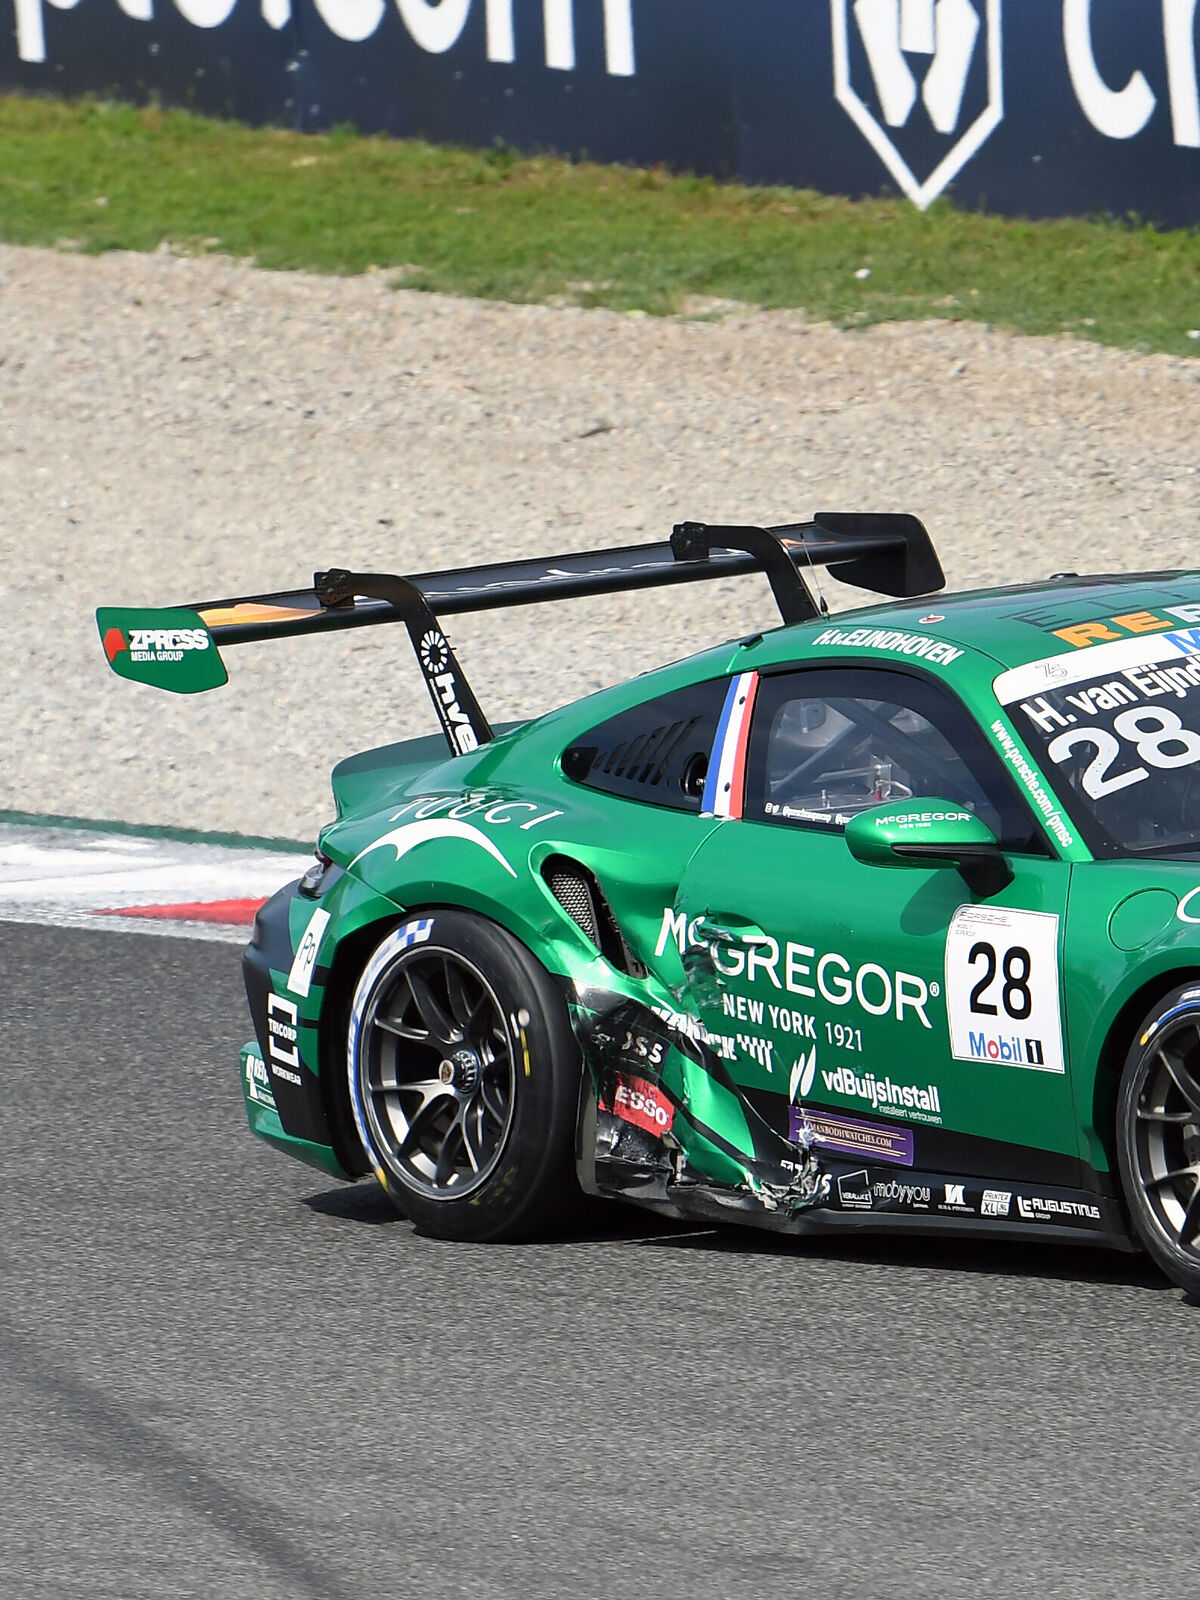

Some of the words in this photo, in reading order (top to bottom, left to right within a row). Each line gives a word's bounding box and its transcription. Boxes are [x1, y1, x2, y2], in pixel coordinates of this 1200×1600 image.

[129, 629, 209, 650] ZPRESS
[131, 651, 156, 661] MEDIA
[157, 651, 184, 662] GROUP
[1020, 696, 1078, 733] H.
[1065, 679, 1139, 716] van
[967, 941, 1033, 1021] 28
[268, 1018, 298, 1042] TRICORP
[722, 993, 764, 1025] NEW
[768, 1005, 818, 1040] YORK
[825, 1021, 863, 1052] 1921
[968, 1031, 1023, 1063] Mobil
[1027, 1039, 1041, 1065] 1
[615, 1085, 668, 1126] ESSO
[821, 1067, 941, 1112] vdBuijsInstall
[1032, 1198, 1101, 1219] AUGUSTINUS
